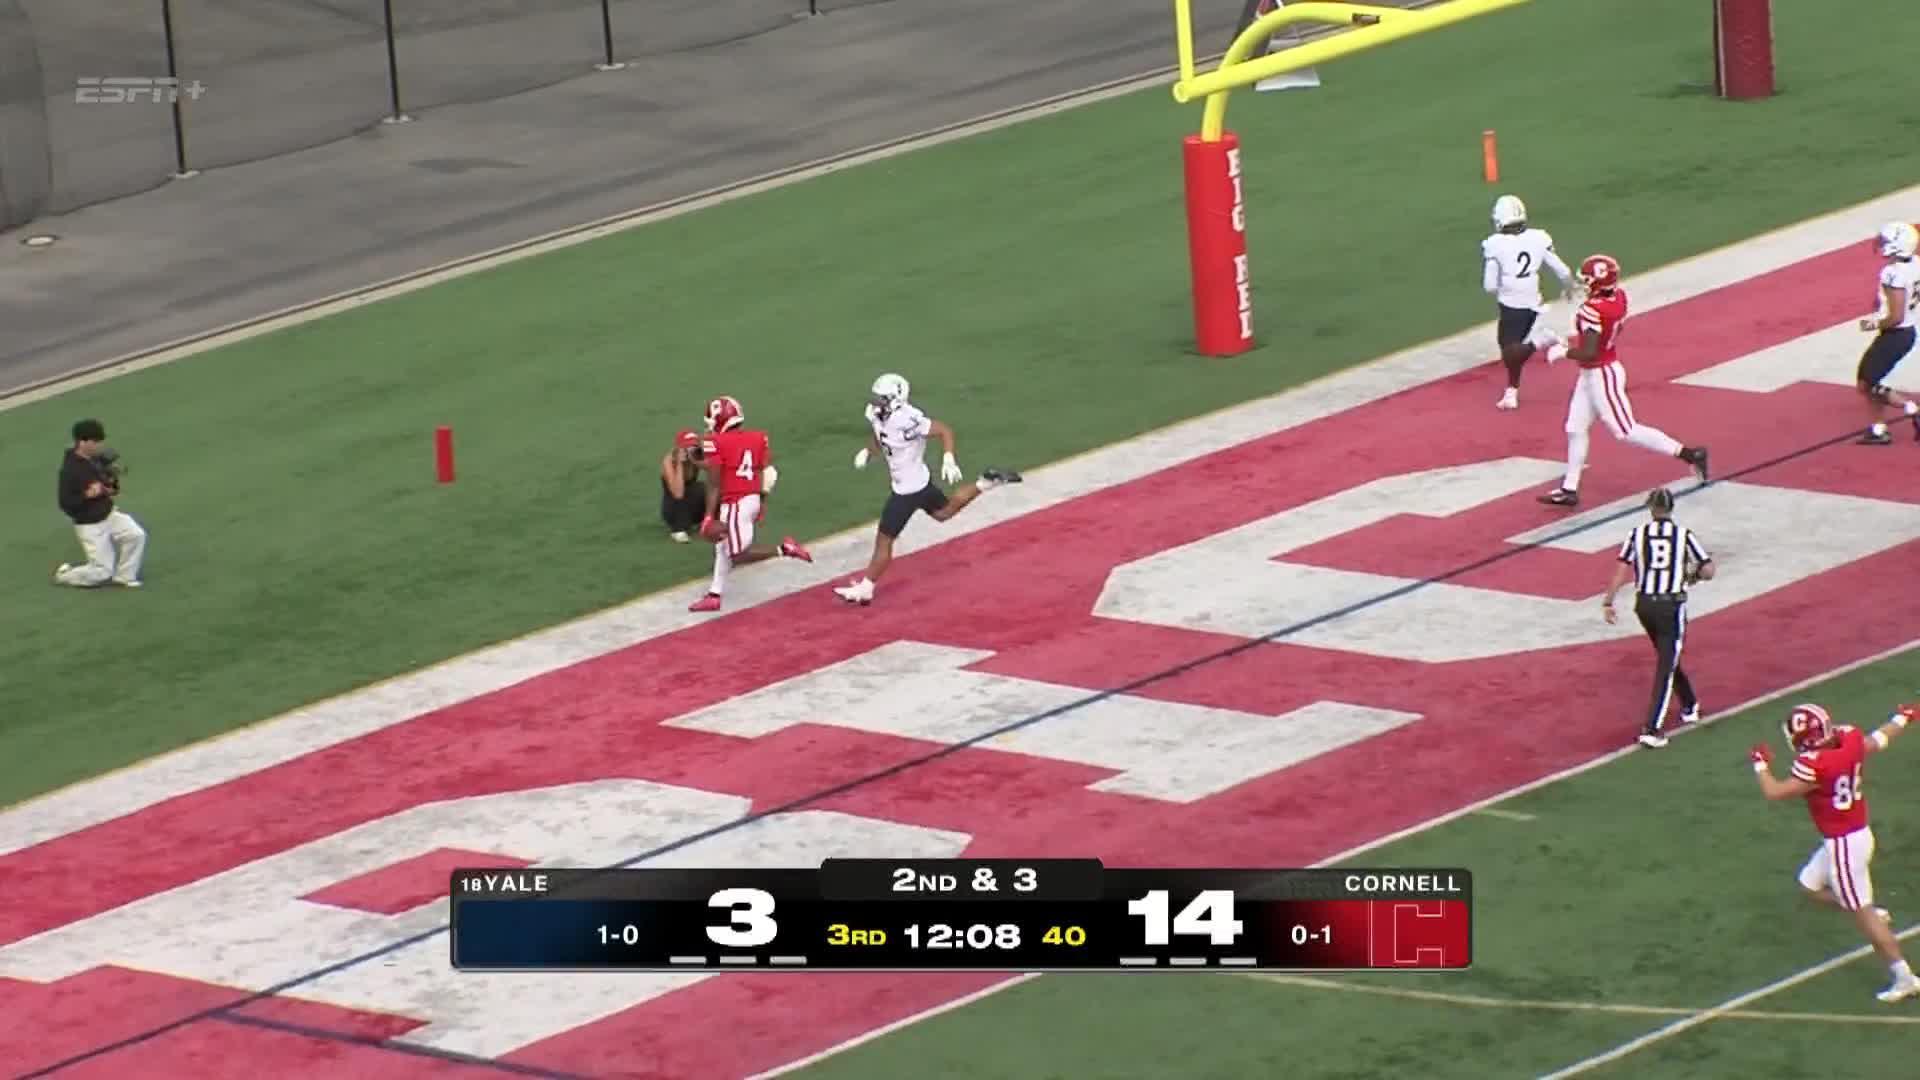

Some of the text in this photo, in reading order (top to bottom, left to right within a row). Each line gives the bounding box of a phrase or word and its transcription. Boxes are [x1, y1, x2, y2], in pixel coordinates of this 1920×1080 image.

[1515, 251, 1531, 279] 2
[735, 449, 754, 480] 4
[1649, 539, 1671, 569] B
